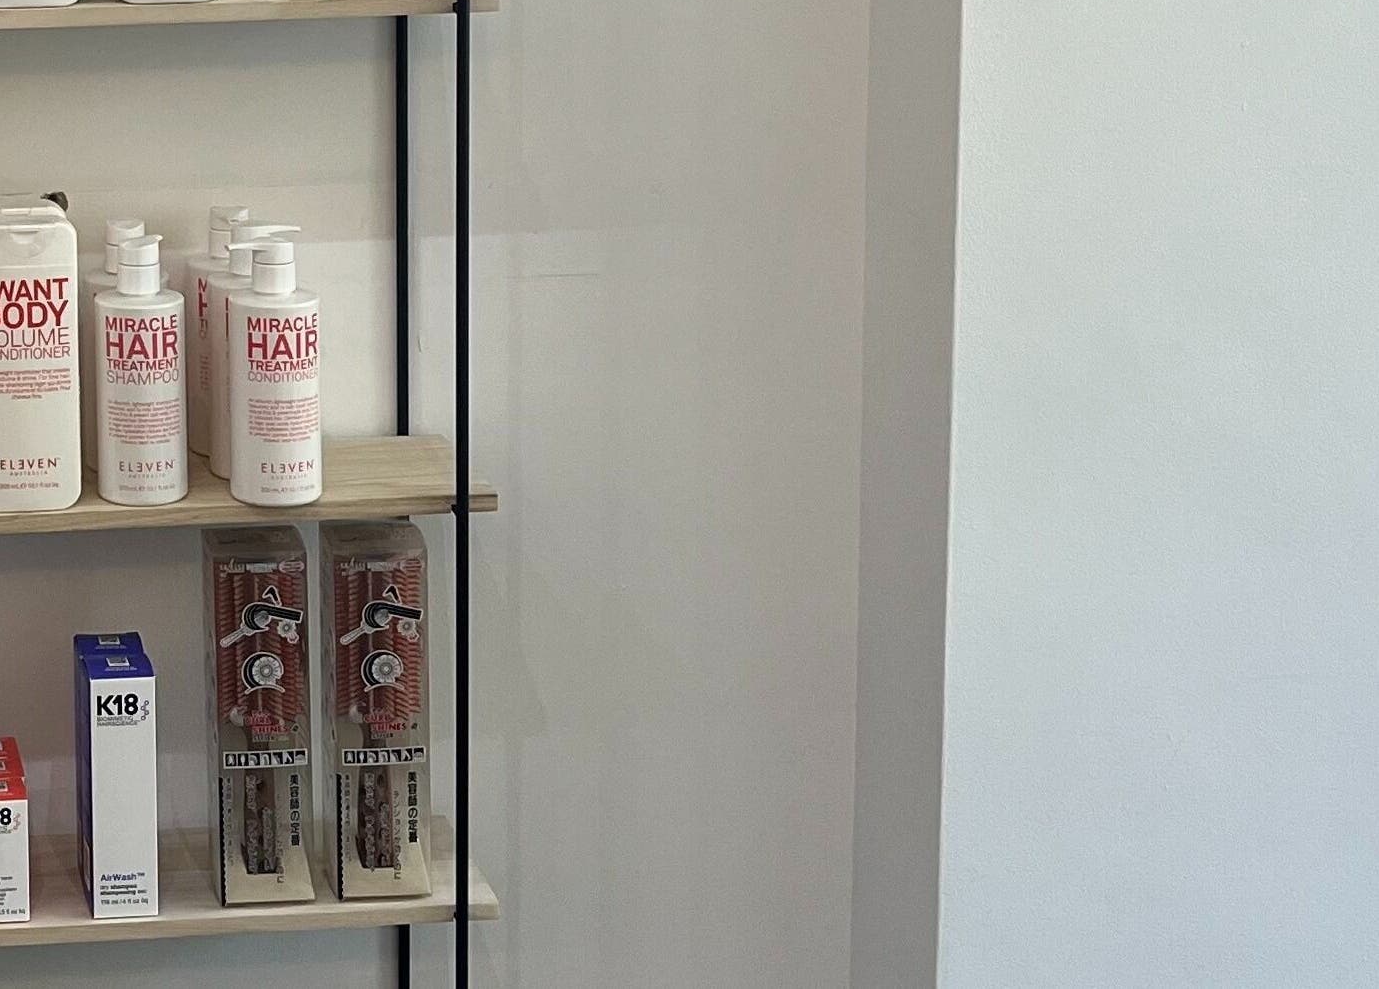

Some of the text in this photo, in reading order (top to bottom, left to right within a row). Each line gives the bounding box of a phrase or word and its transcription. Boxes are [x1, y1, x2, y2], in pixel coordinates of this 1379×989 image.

[105, 314, 177, 333] MIRACLE
[247, 312, 318, 333] MIRACLE
[105, 330, 179, 359] HAIR
[247, 330, 318, 360] HAIR
[107, 357, 179, 372] TREATMENT
[248, 356, 318, 372] TREATMENT
[106, 370, 180, 386] SHAMPOO
[0, 458, 58, 470] ELEVEN
[119, 460, 174, 473] ELEVEN
[261, 459, 314, 473] ELEVEN
[97, 693, 139, 716] K18
